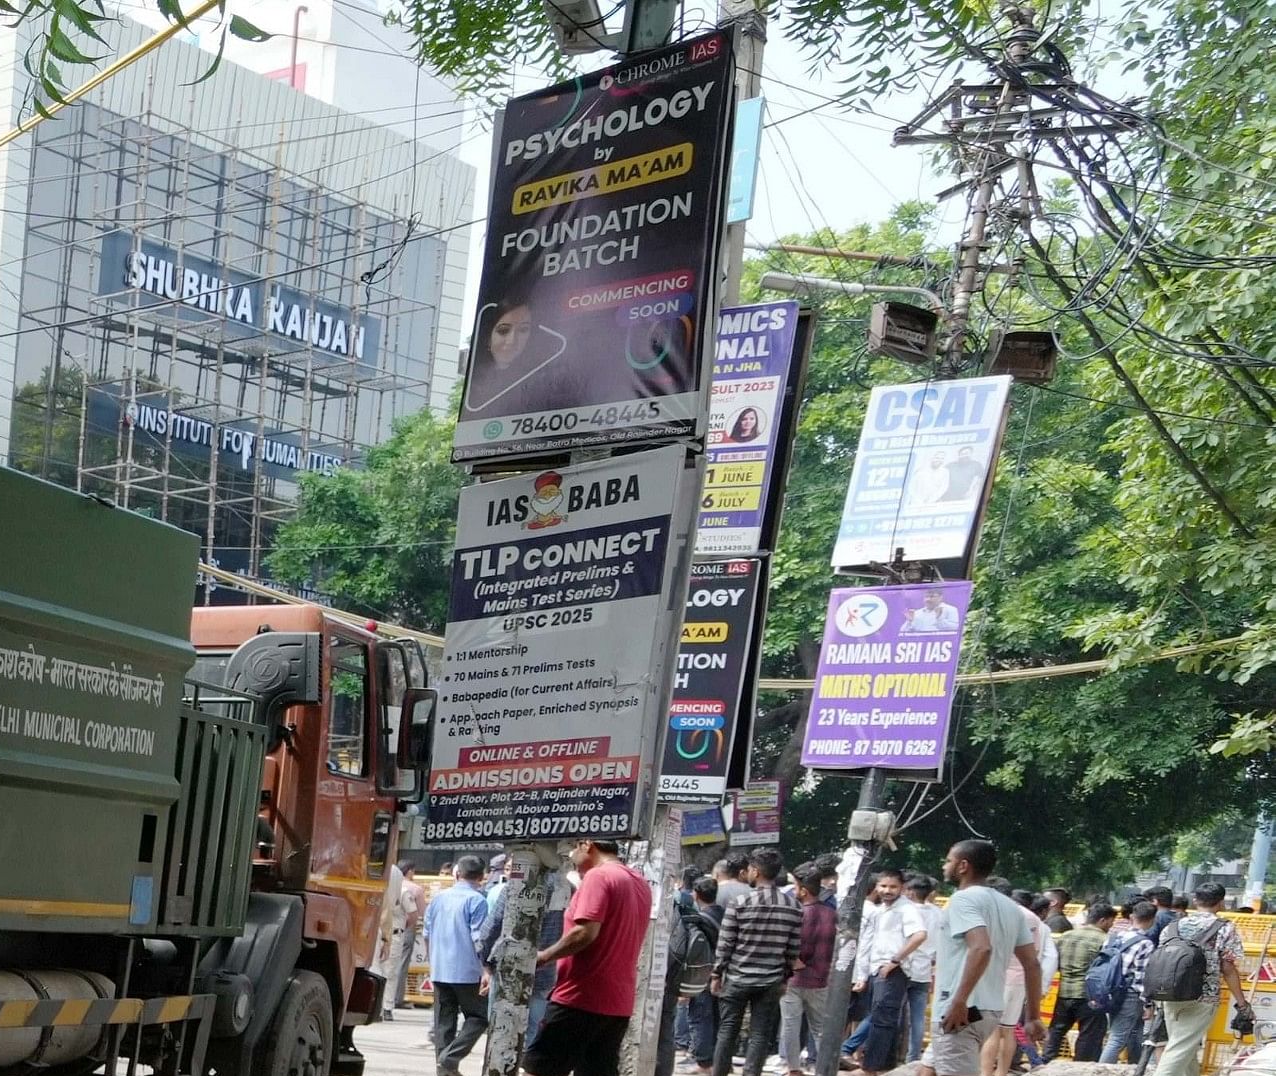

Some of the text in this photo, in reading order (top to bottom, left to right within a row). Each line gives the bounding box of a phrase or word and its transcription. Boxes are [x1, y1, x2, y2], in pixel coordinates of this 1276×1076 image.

[692, 40, 717, 60] IAS
[505, 81, 715, 166] PSYCHOLOGY
[594, 146, 614, 162] by
[519, 172, 599, 208] RAVIKA
[501, 192, 693, 257] FOUNDATION
[543, 235, 640, 277] BATCH
[569, 275, 689, 309] COMMENCING
[629, 299, 680, 320] SOON
[735, 361, 763, 372] JHA
[744, 381, 776, 392] 2023
[511, 401, 661, 436] 78400-48445
[875, 384, 998, 432] CSAT
[721, 472, 754, 483] JUNE
[487, 475, 640, 527] IAS BABA
[717, 497, 747, 508] JULY
[702, 517, 729, 526] JUNE
[461, 528, 661, 580] TLP CONNECT
[728, 563, 749, 573] IAS
[473, 561, 635, 600] (Integrated Prelims &
[483, 579, 620, 613] Mains Test Series)
[503, 608, 593, 632] UPSC 2025
[456, 645, 529, 662] 1:1 Mentorship
[825, 641, 953, 665] RAMANA SRI IAS
[19, 643, 46, 684] कोष
[50, 657, 78, 690] भारत
[78, 663, 110, 695] सरकार
[109, 661, 120, 698] के
[153, 673, 165, 708] से
[454, 658, 596, 682] 70 Mains & 71 Prelims Tests
[452, 676, 619, 704] Babapedia (for Current Affairs)
[819, 673, 947, 699] MATHS OPTIONAL
[503, 707, 537, 720] Paper,
[539, 701, 587, 715] Enriched
[588, 696, 639, 714] Synopsis
[818, 708, 938, 729] 23 Years Experience
[23, 709, 82, 747] MUNICIPAL
[84, 720, 156, 756] CORPORATION
[448, 727, 456, 737] &
[680, 717, 716, 727] SOON
[469, 742, 598, 763] ONLINE & OFFLINE
[808, 739, 937, 756] PHONE: 87 5070 6262
[432, 760, 632, 791] ADMISSIONS OPEN
[439, 786, 630, 806] 2nd Floor, Plot 22-B, Rajinder Nagar,
[457, 800, 604, 818] Landmark: Above Domino's
[426, 814, 630, 840] 8826490453/8077036613
